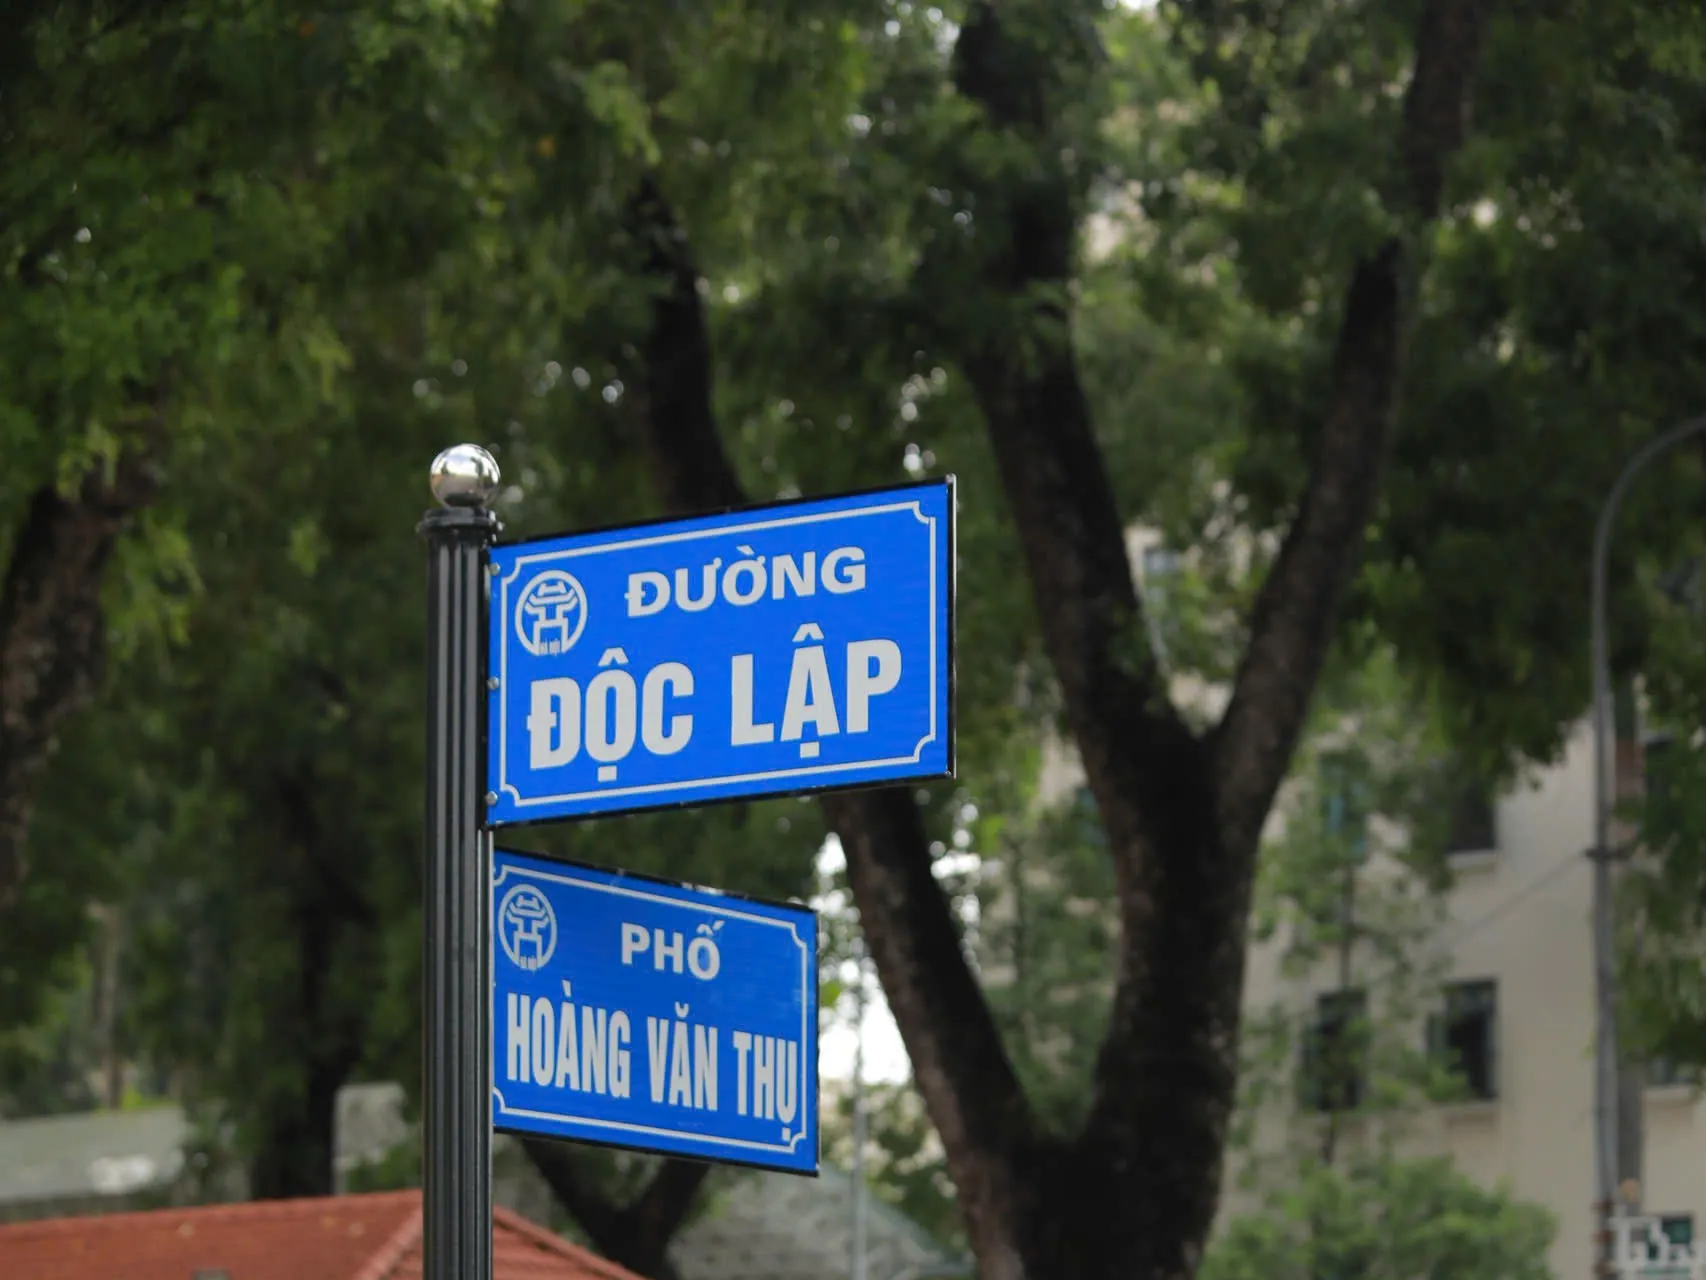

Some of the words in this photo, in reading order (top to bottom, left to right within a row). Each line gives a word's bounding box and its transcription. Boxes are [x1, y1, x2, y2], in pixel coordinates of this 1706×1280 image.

[625, 545, 866, 617] ĐƯỜNG
[527, 648, 695, 782] ĐỘC
[731, 623, 902, 758] LẬP
[622, 920, 725, 980] PHỐ
[507, 980, 631, 1099] HOÀNG
[647, 1002, 718, 1111] VĂN
[733, 1030, 798, 1142] THỤ
